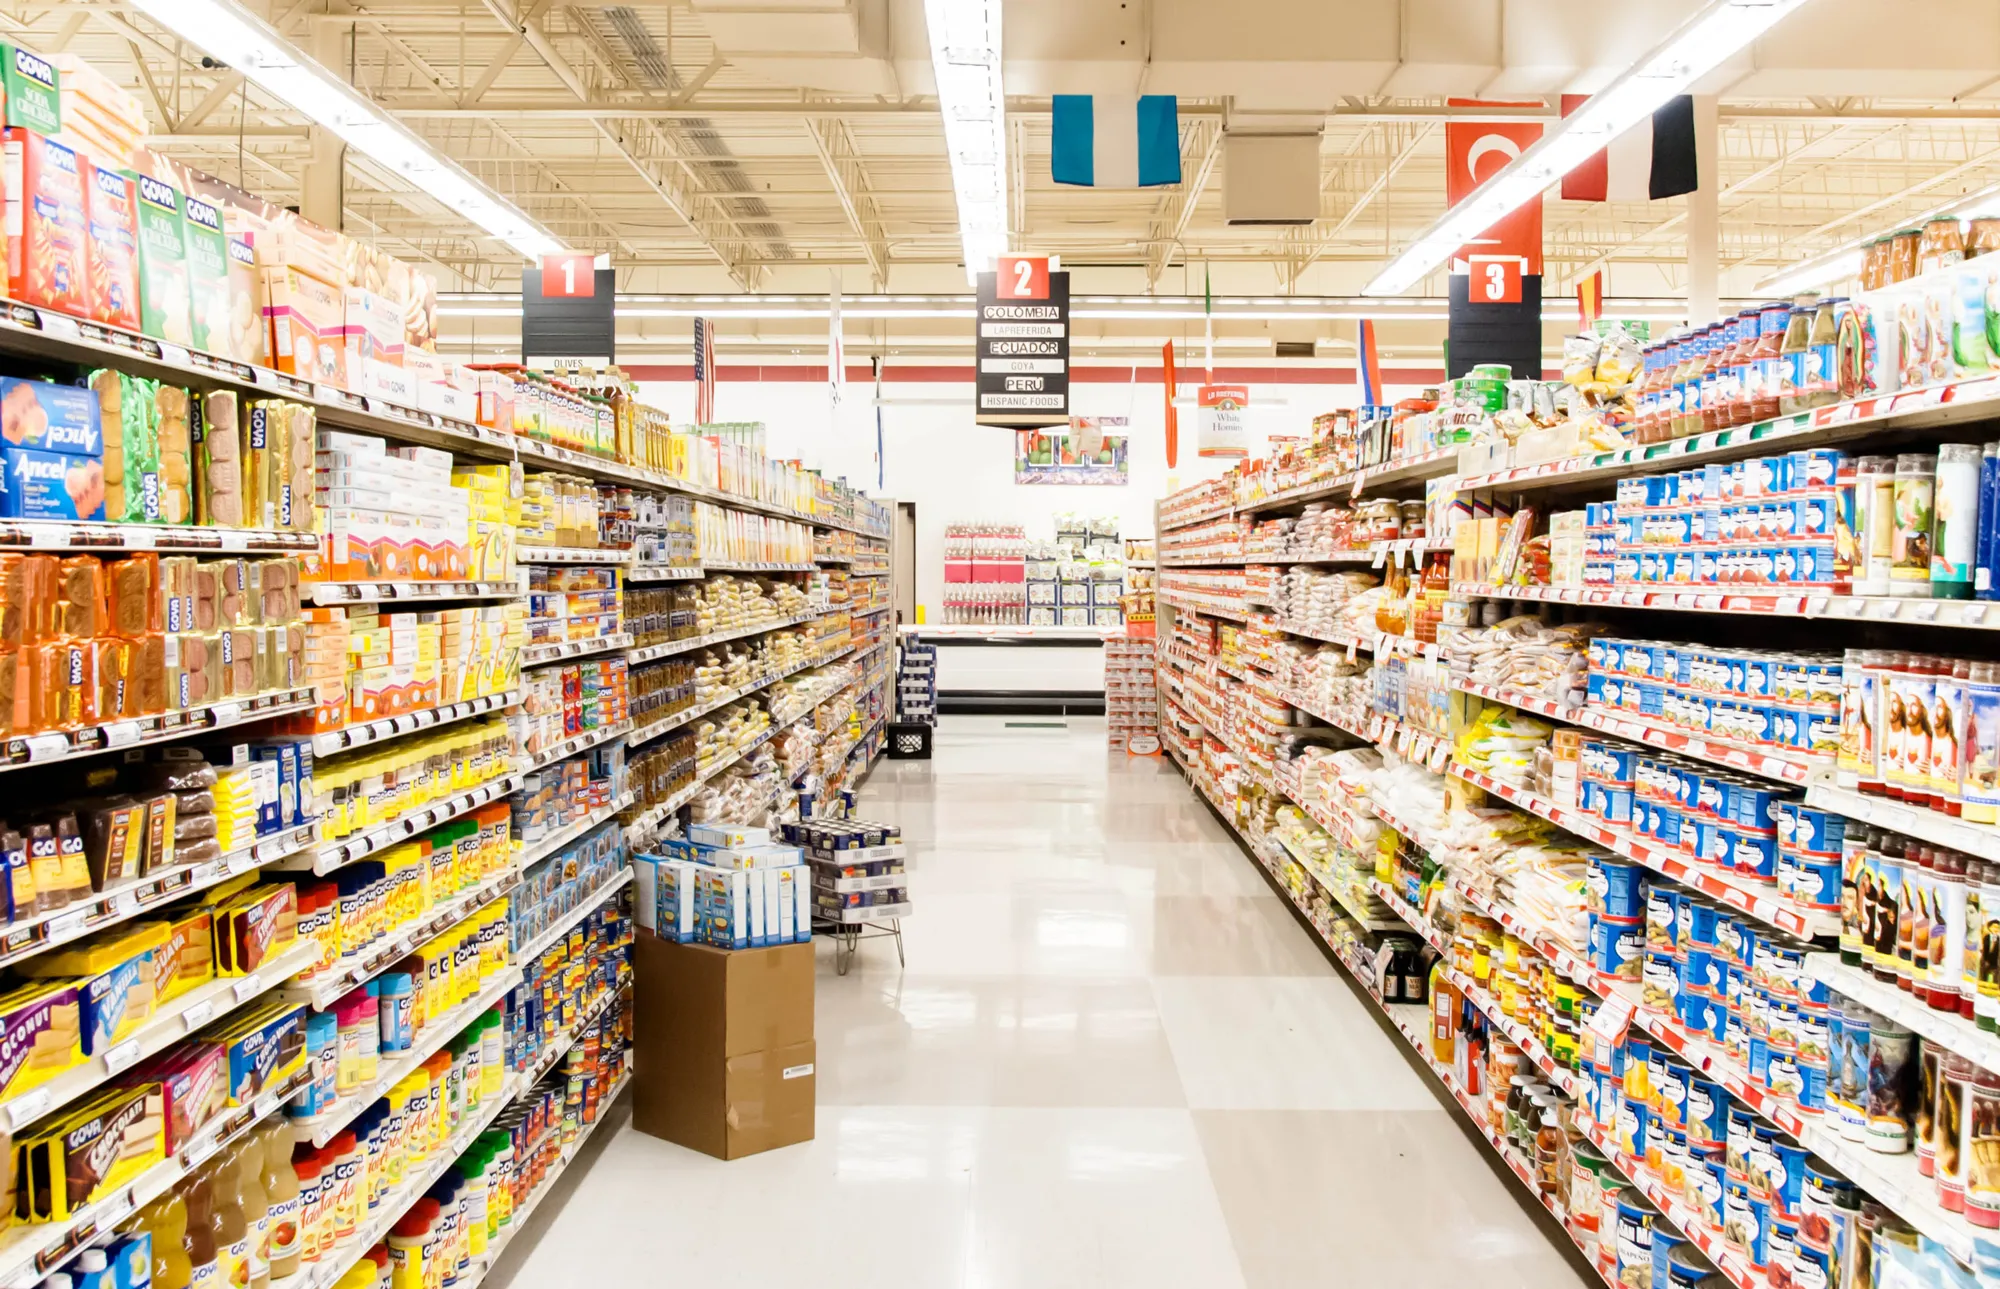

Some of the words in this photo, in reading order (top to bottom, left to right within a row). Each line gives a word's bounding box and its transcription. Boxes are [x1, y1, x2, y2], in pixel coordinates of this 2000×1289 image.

[17, 51, 53, 83] GOYA
[98, 171, 125, 198] GOYA
[141, 177, 175, 207] GOYA
[187, 199, 218, 228] GOYA
[231, 242, 254, 264] GOYA
[561, 260, 574, 294] 1
[1014, 260, 1032, 296] 2
[1486, 263, 1505, 300] 3
[985, 307, 1058, 319] COLOMBIA
[994, 326, 1052, 335] LAPREFERIDA
[991, 343, 1058, 354] ECUADOR
[554, 359, 583, 368] OLIVES
[1011, 362, 1035, 371] GOYA
[987, 397, 1027, 406] HISPANIC
[1030, 397, 1059, 406] FOODS
[192, 402, 200, 441] GOYA
[252, 409, 265, 448] GOYA
[46, 424, 98, 452] Ancel
[14, 453, 67, 482] Ancel
[144, 473, 158, 518] GOYA
[170, 598, 180, 632] GOYA
[223, 632, 232, 663] GOYA
[72, 650, 82, 684] GOYA
[181, 674, 189, 707] GOYA
[249, 906, 264, 924] GOYA
[342, 903, 357, 912] GO
[299, 922, 315, 934] GO
[154, 933, 186, 978] GUAVA
[91, 974, 112, 998] GOYA
[101, 964, 139, 1020] VANILLA
[0, 1008, 49, 1068] OCONUT
[243, 1031, 264, 1052] GOYA
[173, 1076, 191, 1099] GOYA
[411, 1097, 429, 1111] GO
[69, 1119, 101, 1149] GOYA
[90, 1099, 144, 1170] CHOCOLATE
[337, 1165, 354, 1179] GO
[268, 1199, 297, 1217] GOYA
